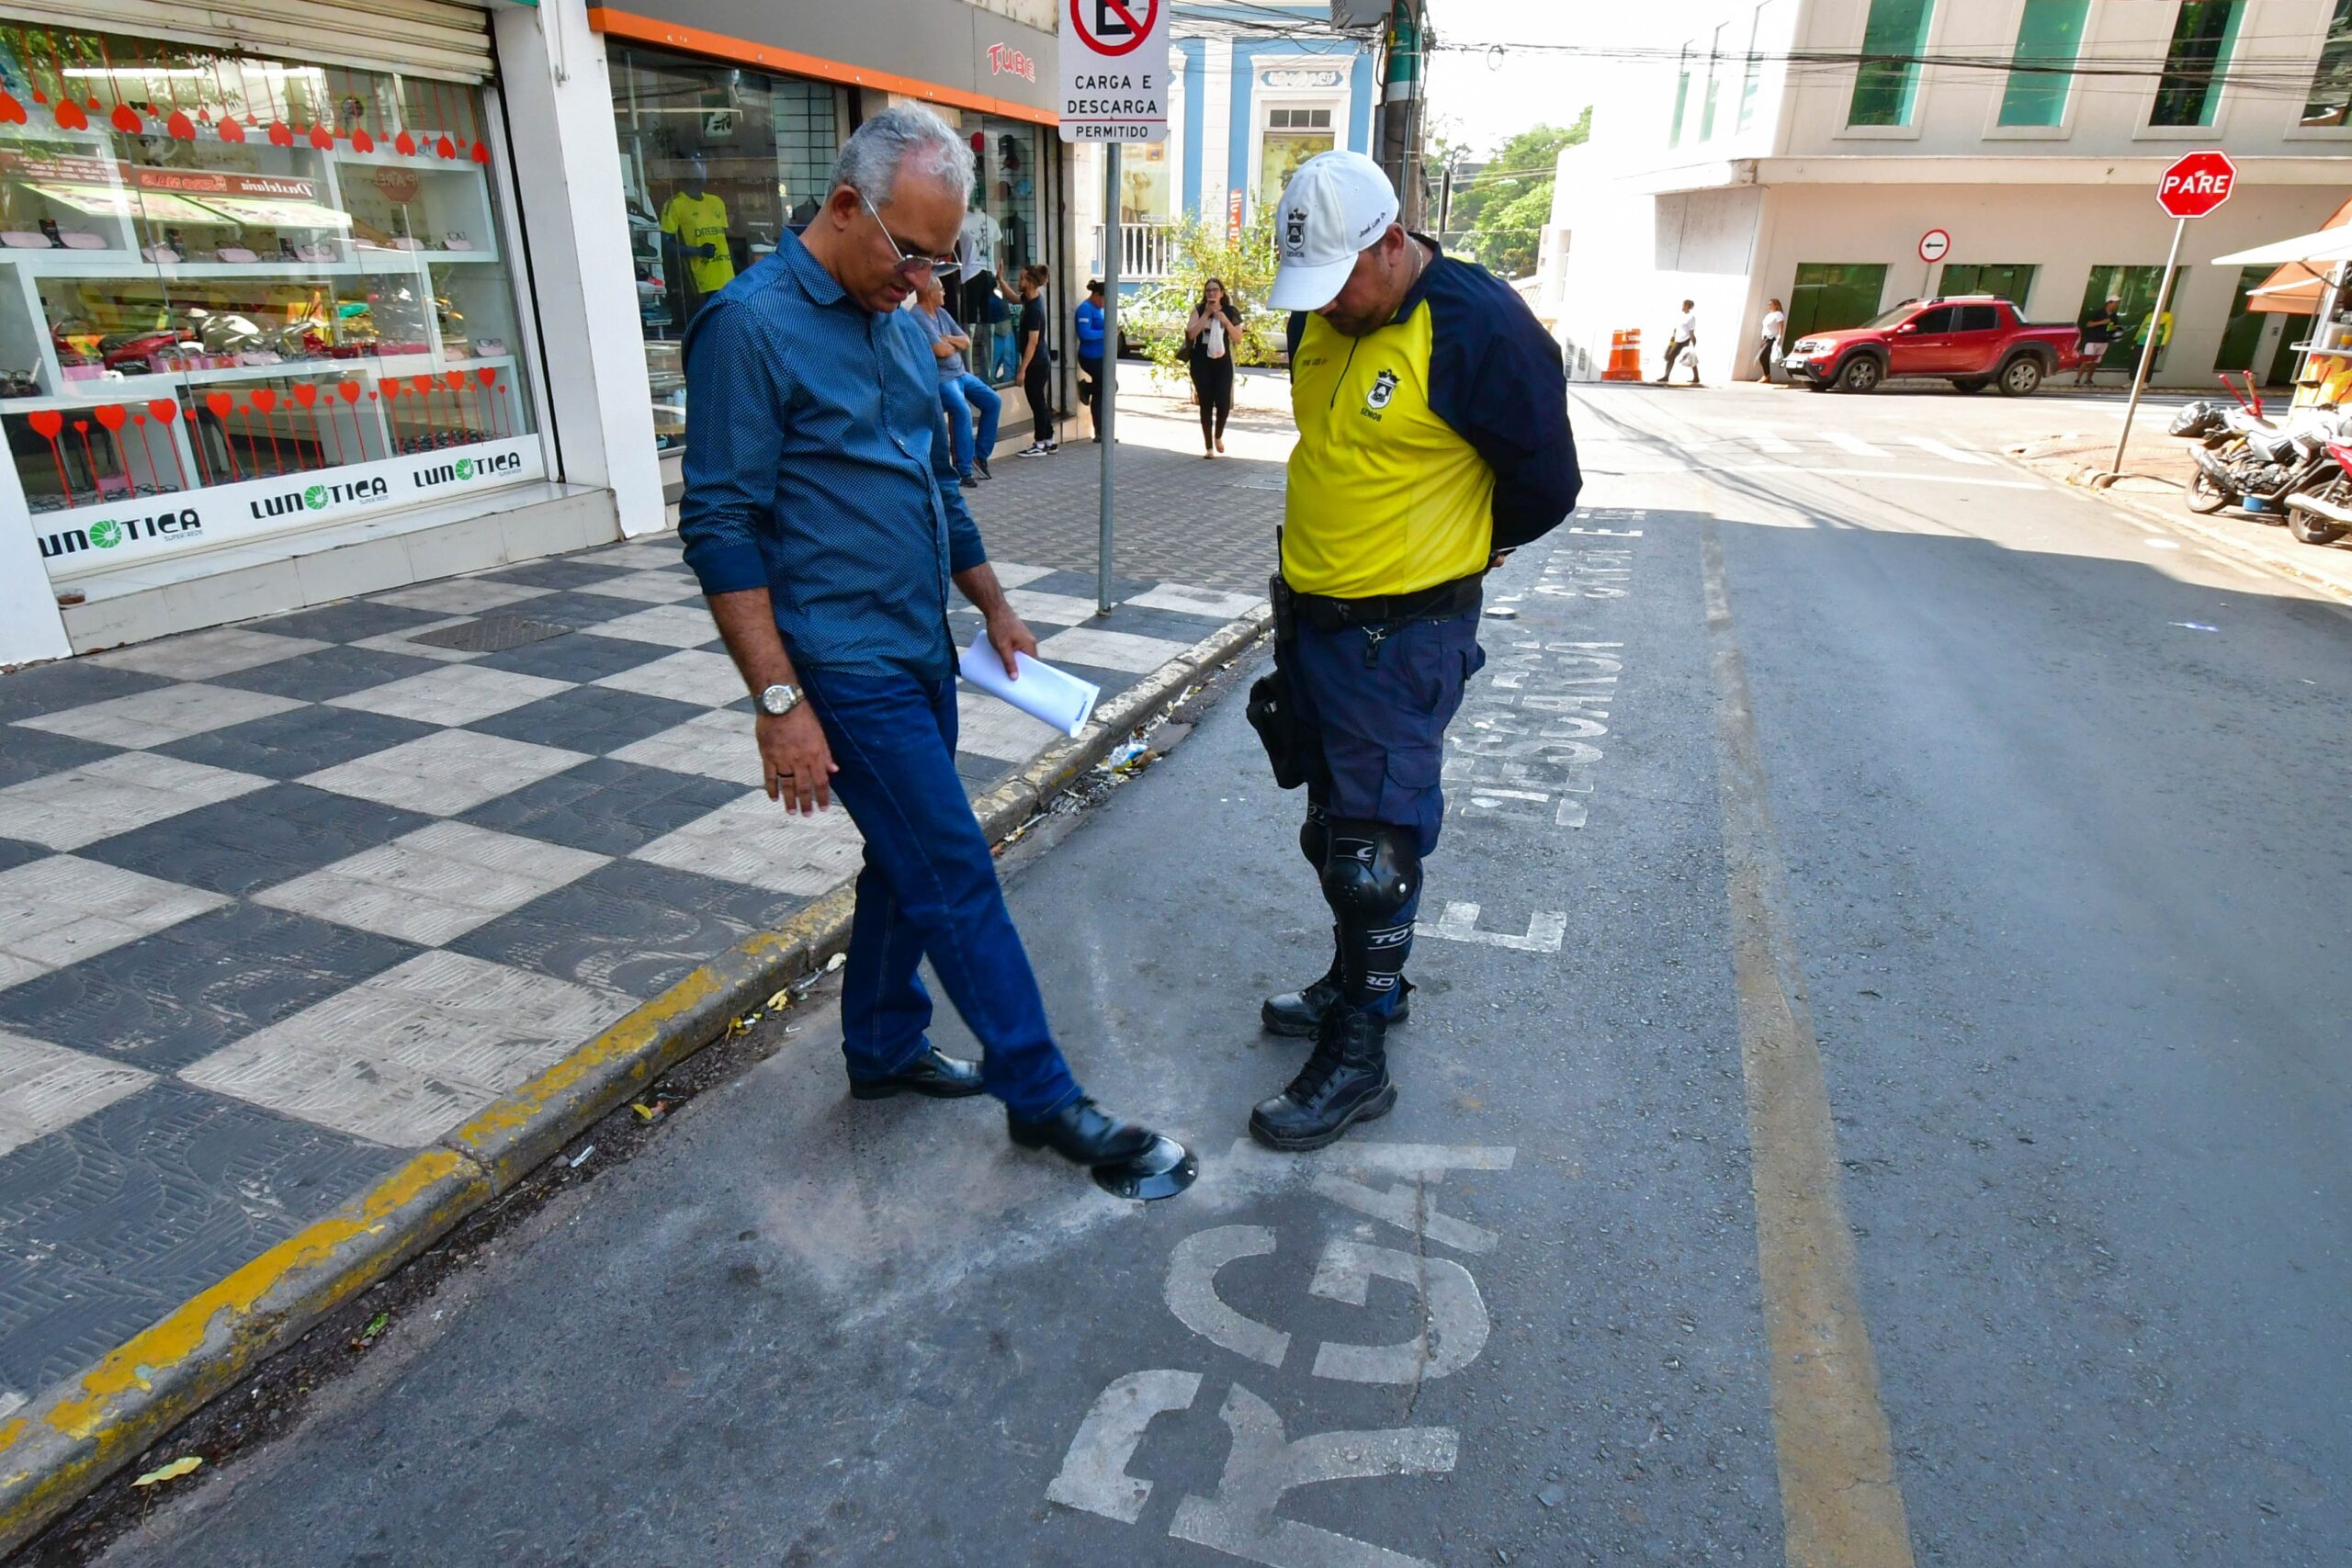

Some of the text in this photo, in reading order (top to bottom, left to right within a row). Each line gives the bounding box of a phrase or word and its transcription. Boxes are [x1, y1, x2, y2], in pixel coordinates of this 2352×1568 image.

[1075, 75, 1151, 89] CARGA E
[1068, 100, 1158, 114] DESCARGA
[1076, 126, 1148, 138] PERMITIDO
[2163, 175, 2230, 195] PARE
[1361, 407, 1382, 422] SEMOB
[37, 508, 201, 558] UNOTICA
